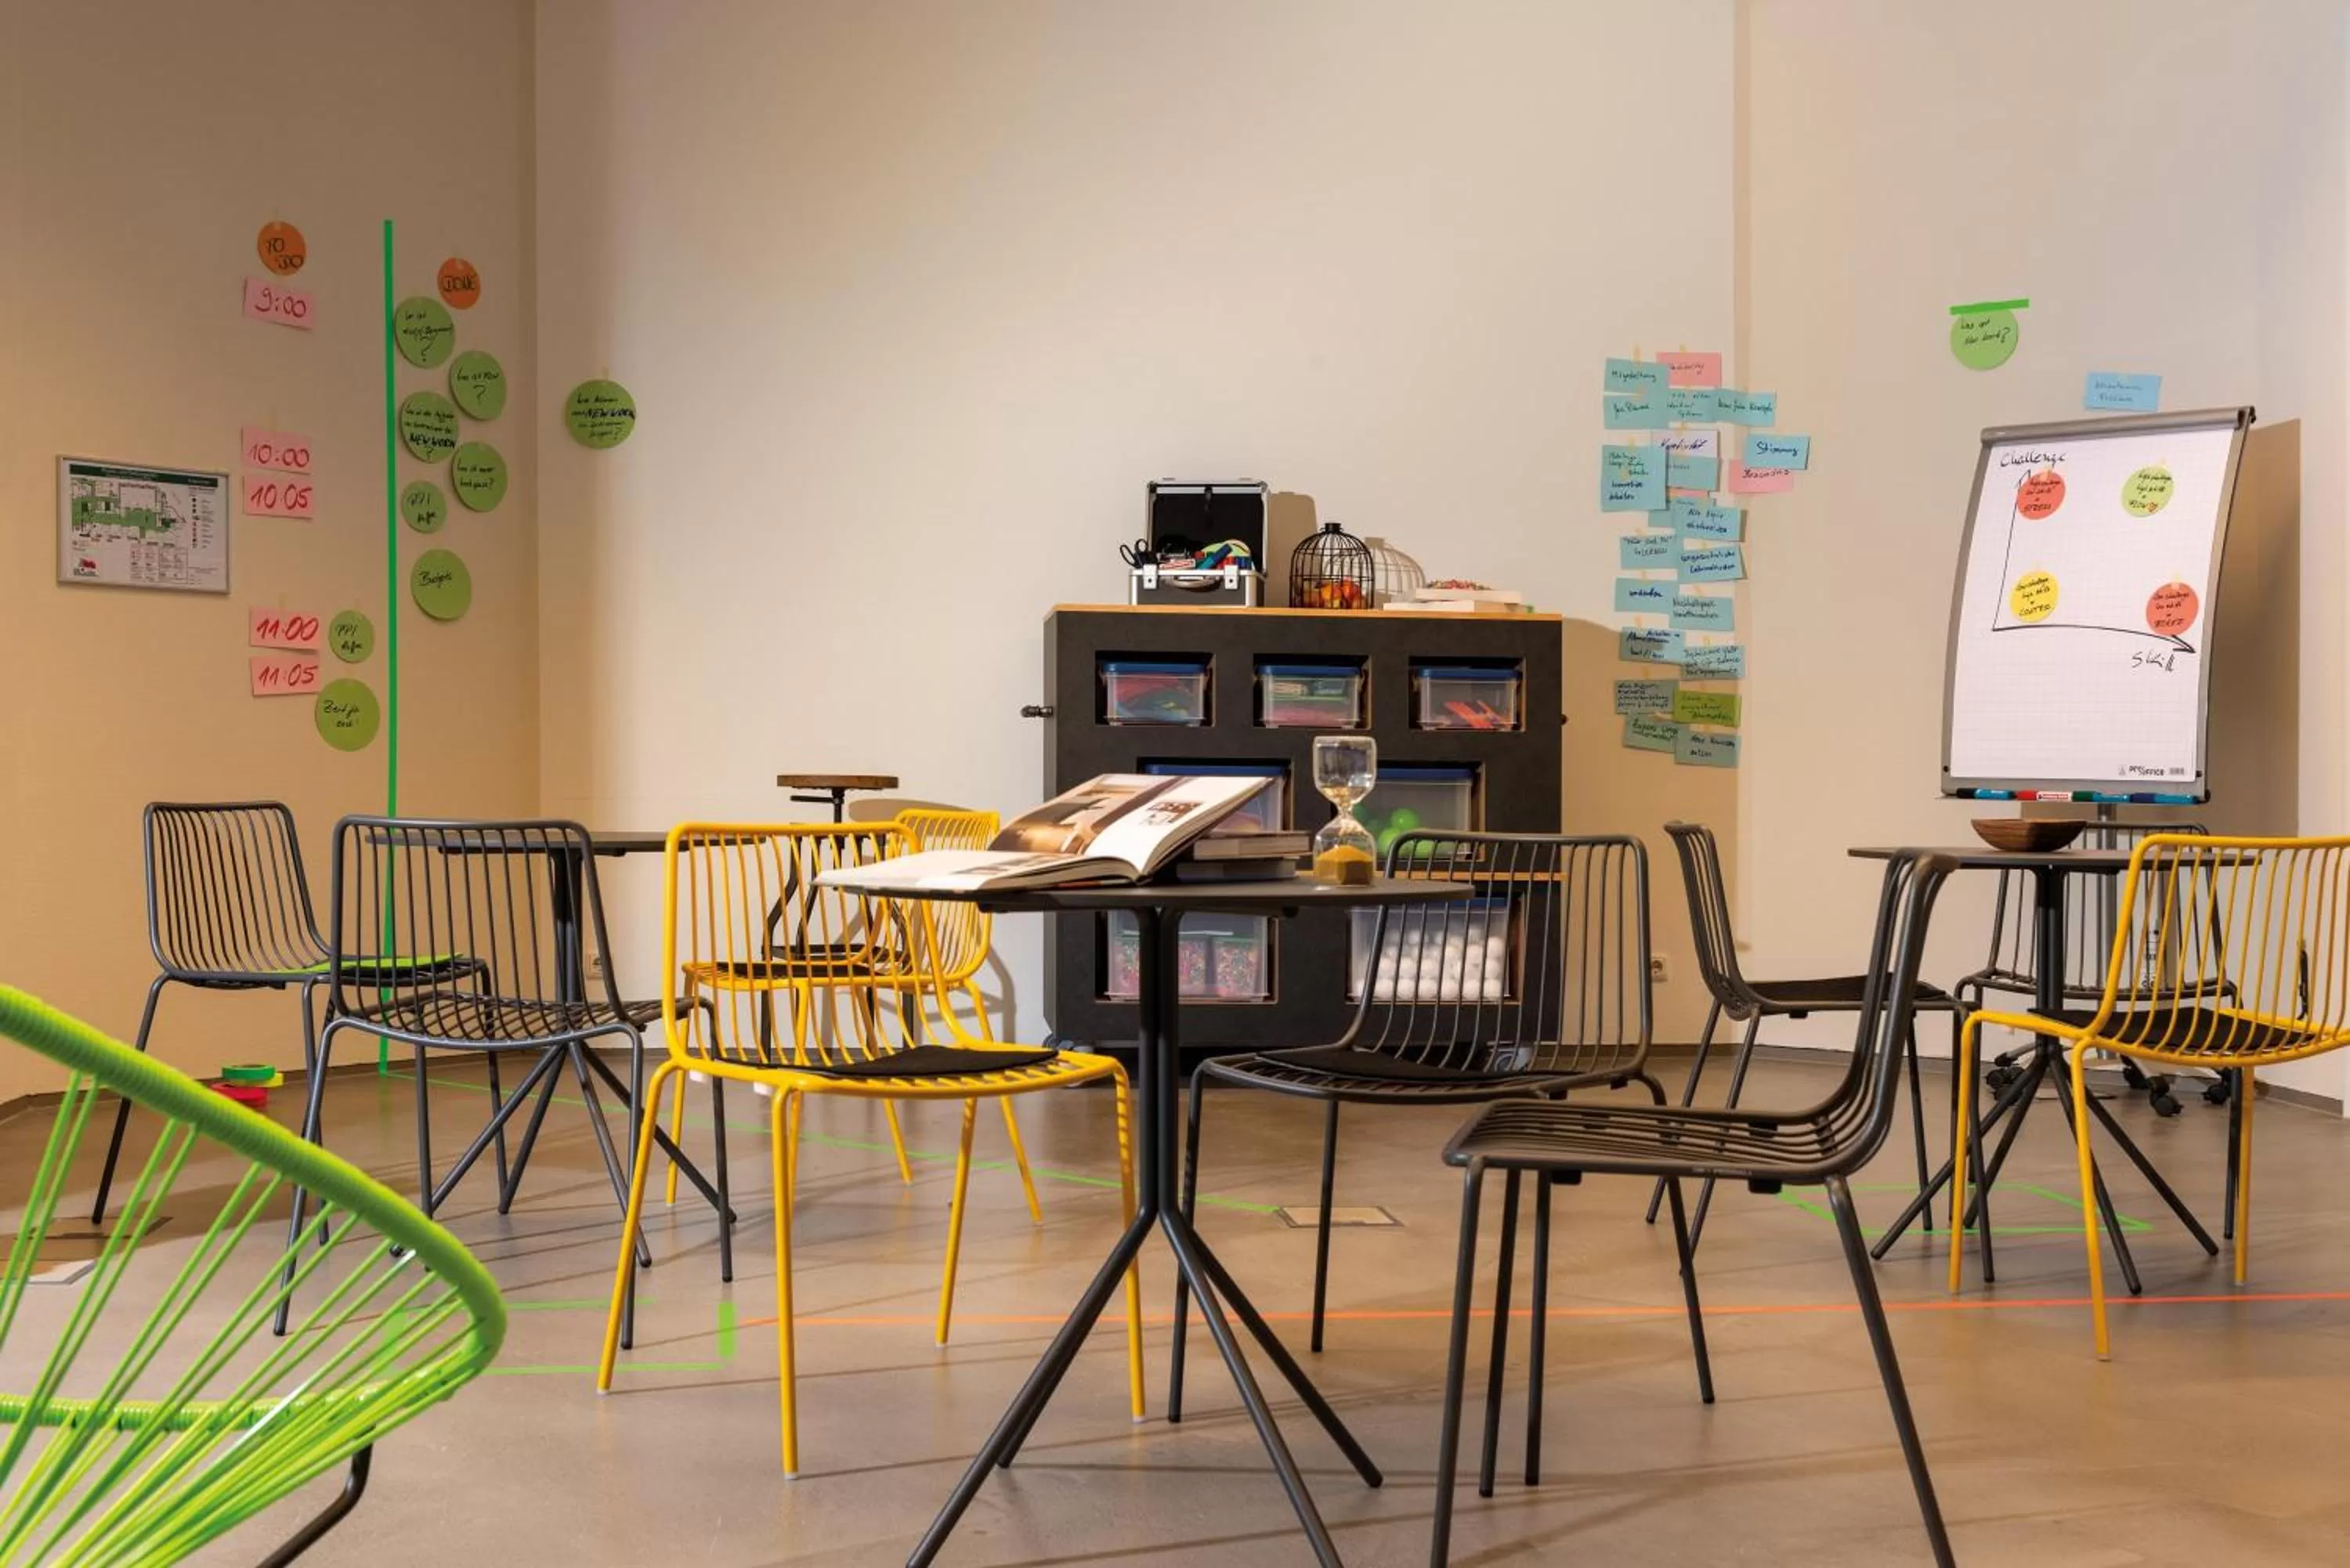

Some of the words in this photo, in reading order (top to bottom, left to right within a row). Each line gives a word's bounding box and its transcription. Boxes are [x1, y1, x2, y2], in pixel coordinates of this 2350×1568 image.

[255, 287, 308, 318] 9:00
[248, 443, 310, 468] 10:00
[1755, 441, 1799, 457] Stimmung
[1999, 450, 2068, 469] Challenge
[258, 663, 319, 688] 11:05
